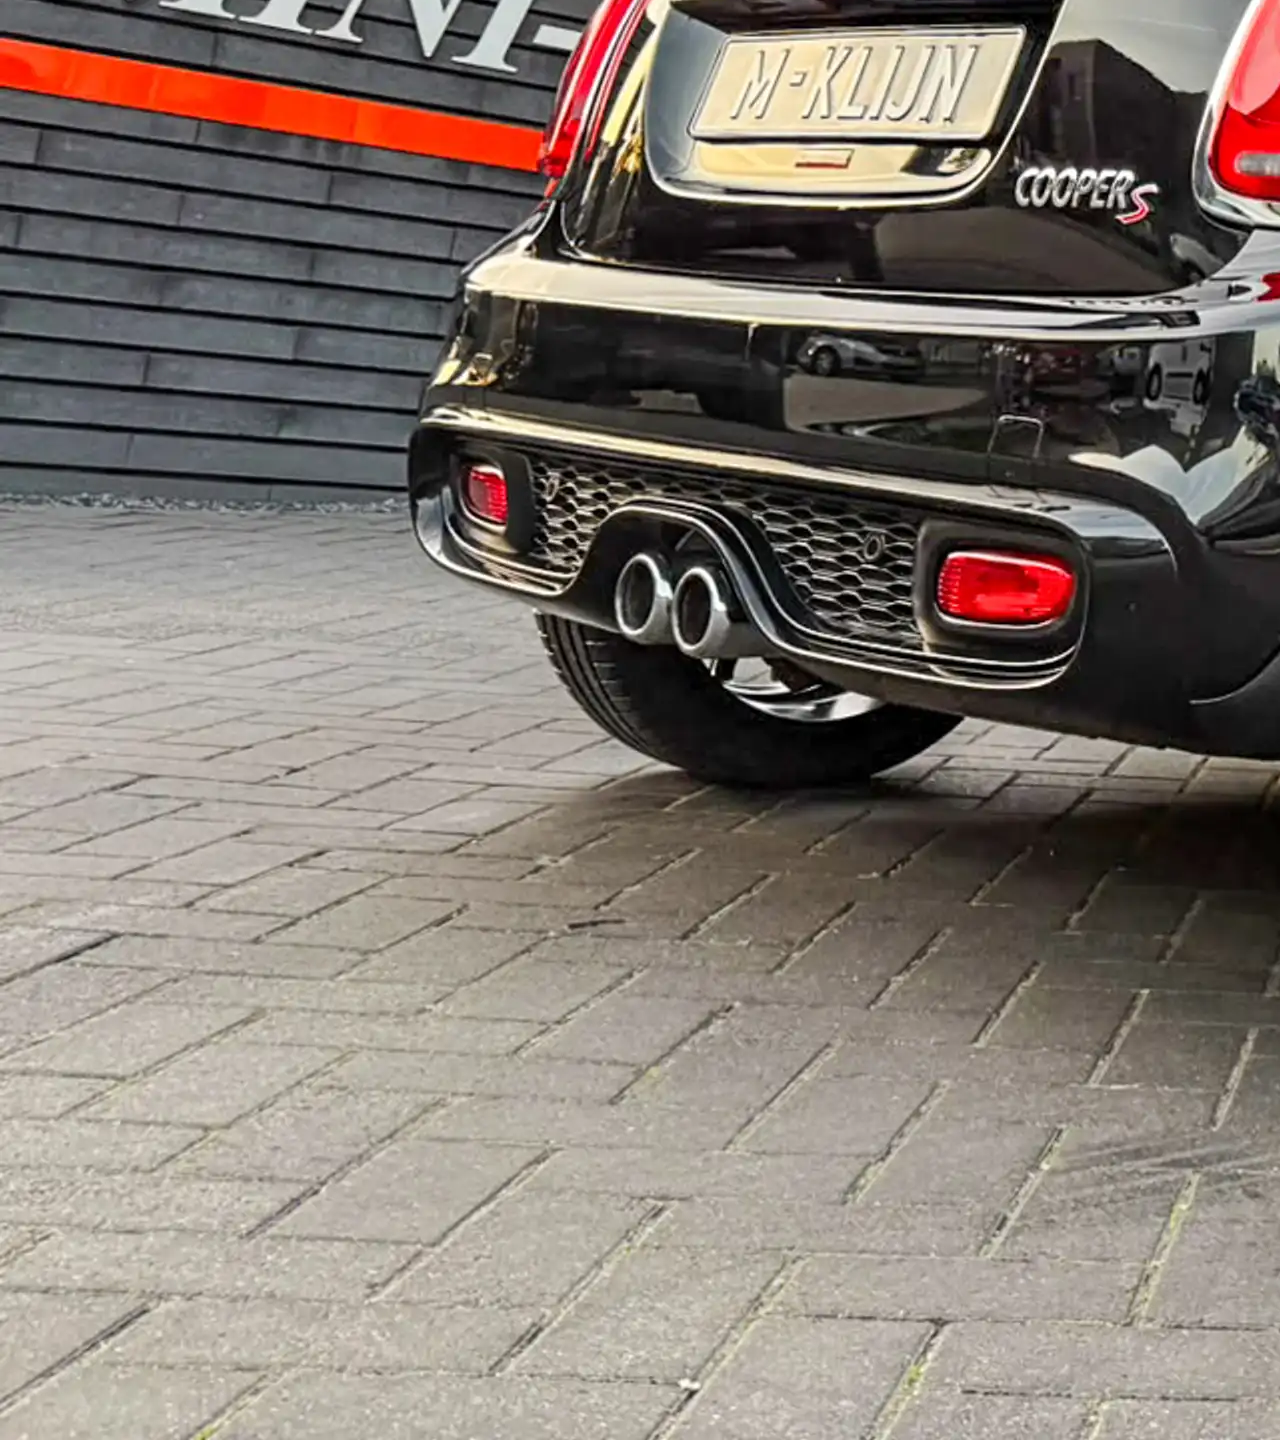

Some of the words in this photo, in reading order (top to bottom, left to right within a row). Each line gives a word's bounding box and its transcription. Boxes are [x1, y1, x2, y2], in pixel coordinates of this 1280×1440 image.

[729, 42, 980, 126] M-KLIJN
[1014, 165, 1136, 210] COOPER
[1114, 182, 1160, 226] S
